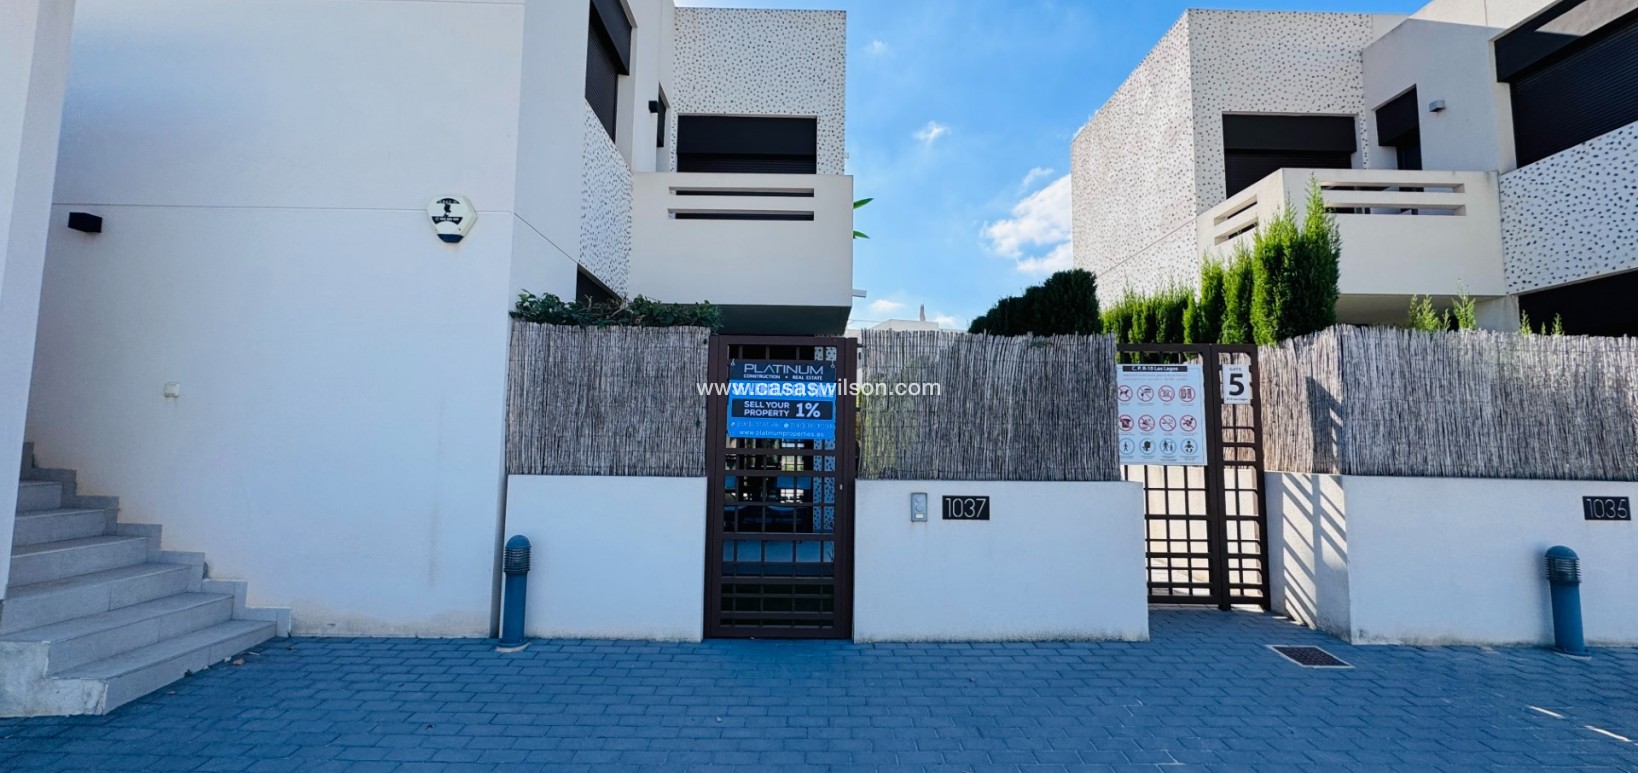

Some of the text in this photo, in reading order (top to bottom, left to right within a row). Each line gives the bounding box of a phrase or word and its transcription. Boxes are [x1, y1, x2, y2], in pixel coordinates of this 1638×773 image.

[743, 364, 824, 375] PLATINUM
[1229, 373, 1245, 396] 5
[765, 401, 790, 409] YOUR
[796, 402, 821, 418] 1%
[743, 409, 790, 417] PROPERTY
[739, 430, 824, 438] www.platinumproperties.es
[945, 498, 987, 518] 1037
[1586, 498, 1628, 519] 1035
